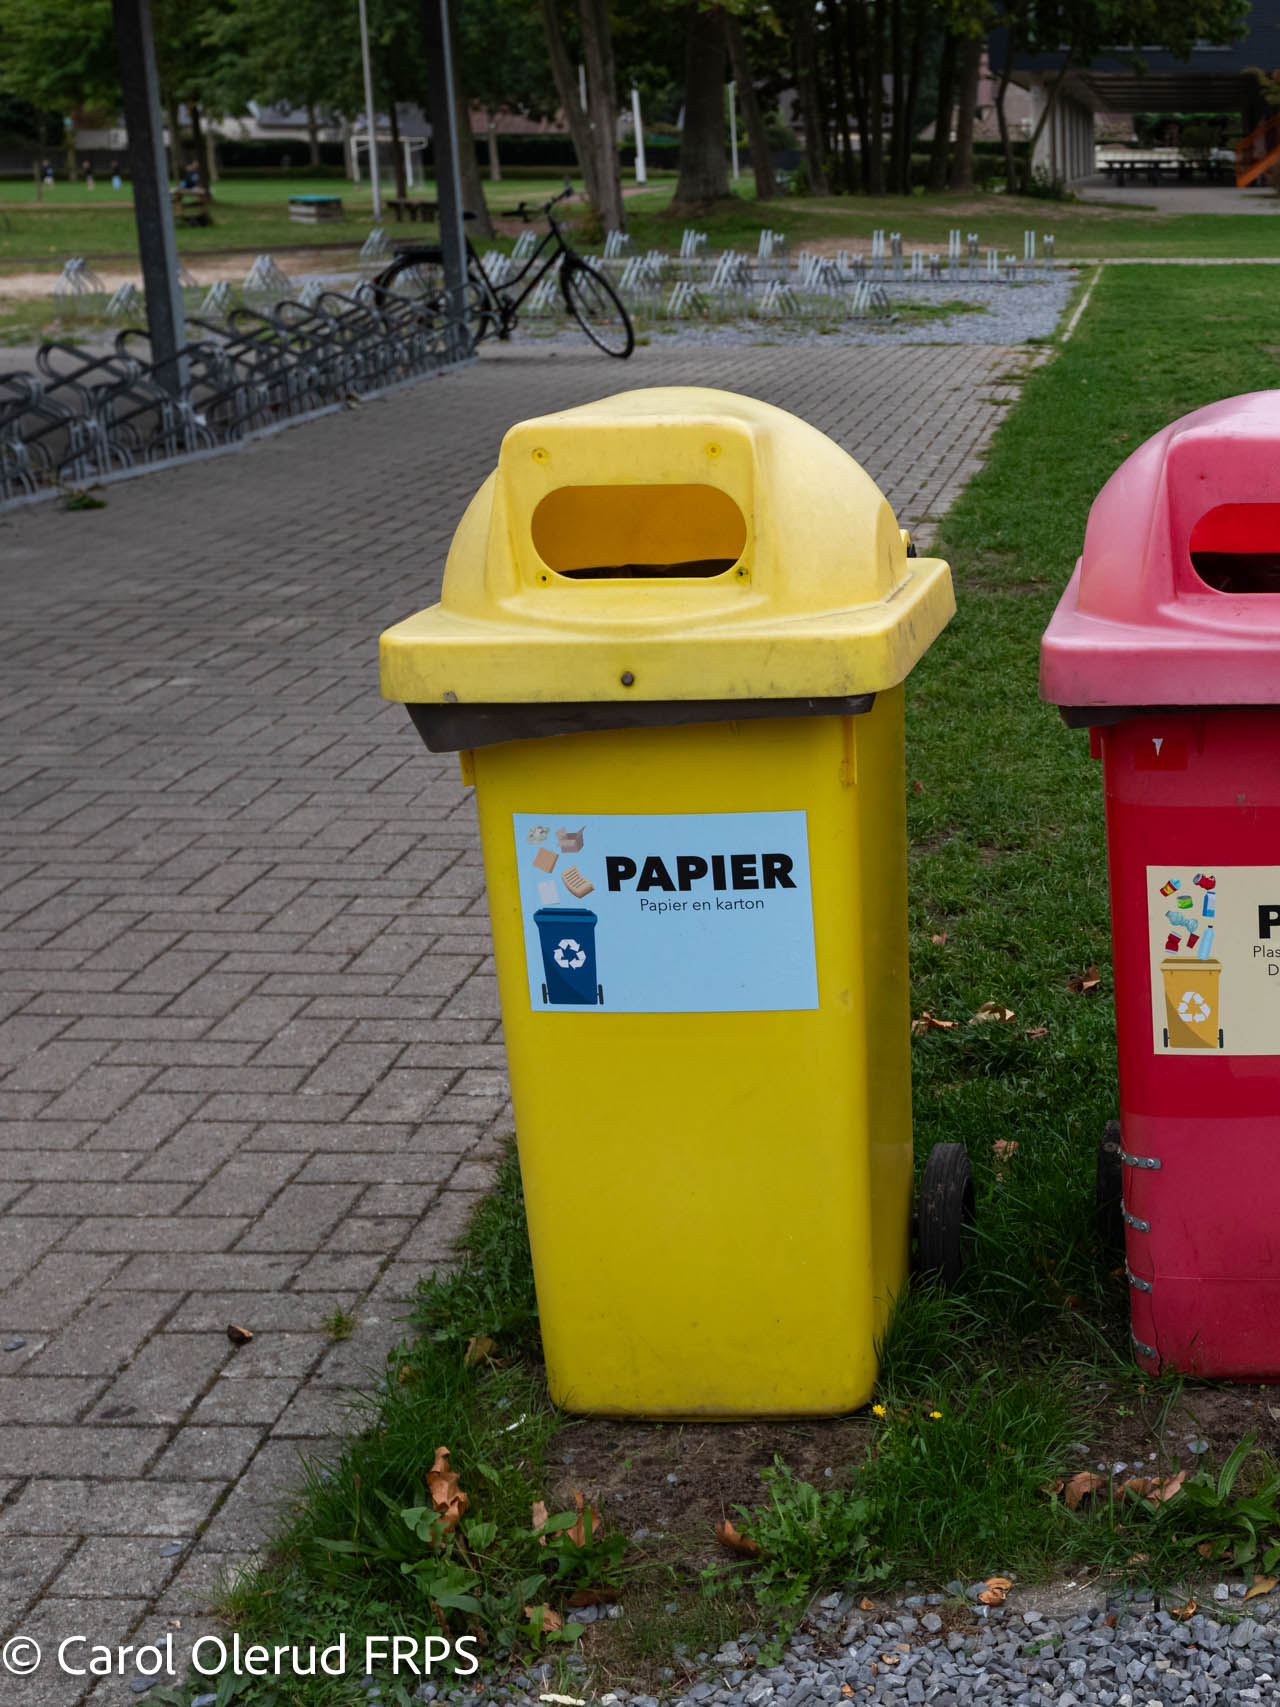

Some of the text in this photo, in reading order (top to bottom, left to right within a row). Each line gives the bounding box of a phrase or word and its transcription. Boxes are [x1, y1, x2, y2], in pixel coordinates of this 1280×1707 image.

[606, 853, 797, 892] PAPIER
[640, 897, 765, 914] Papier en karton
